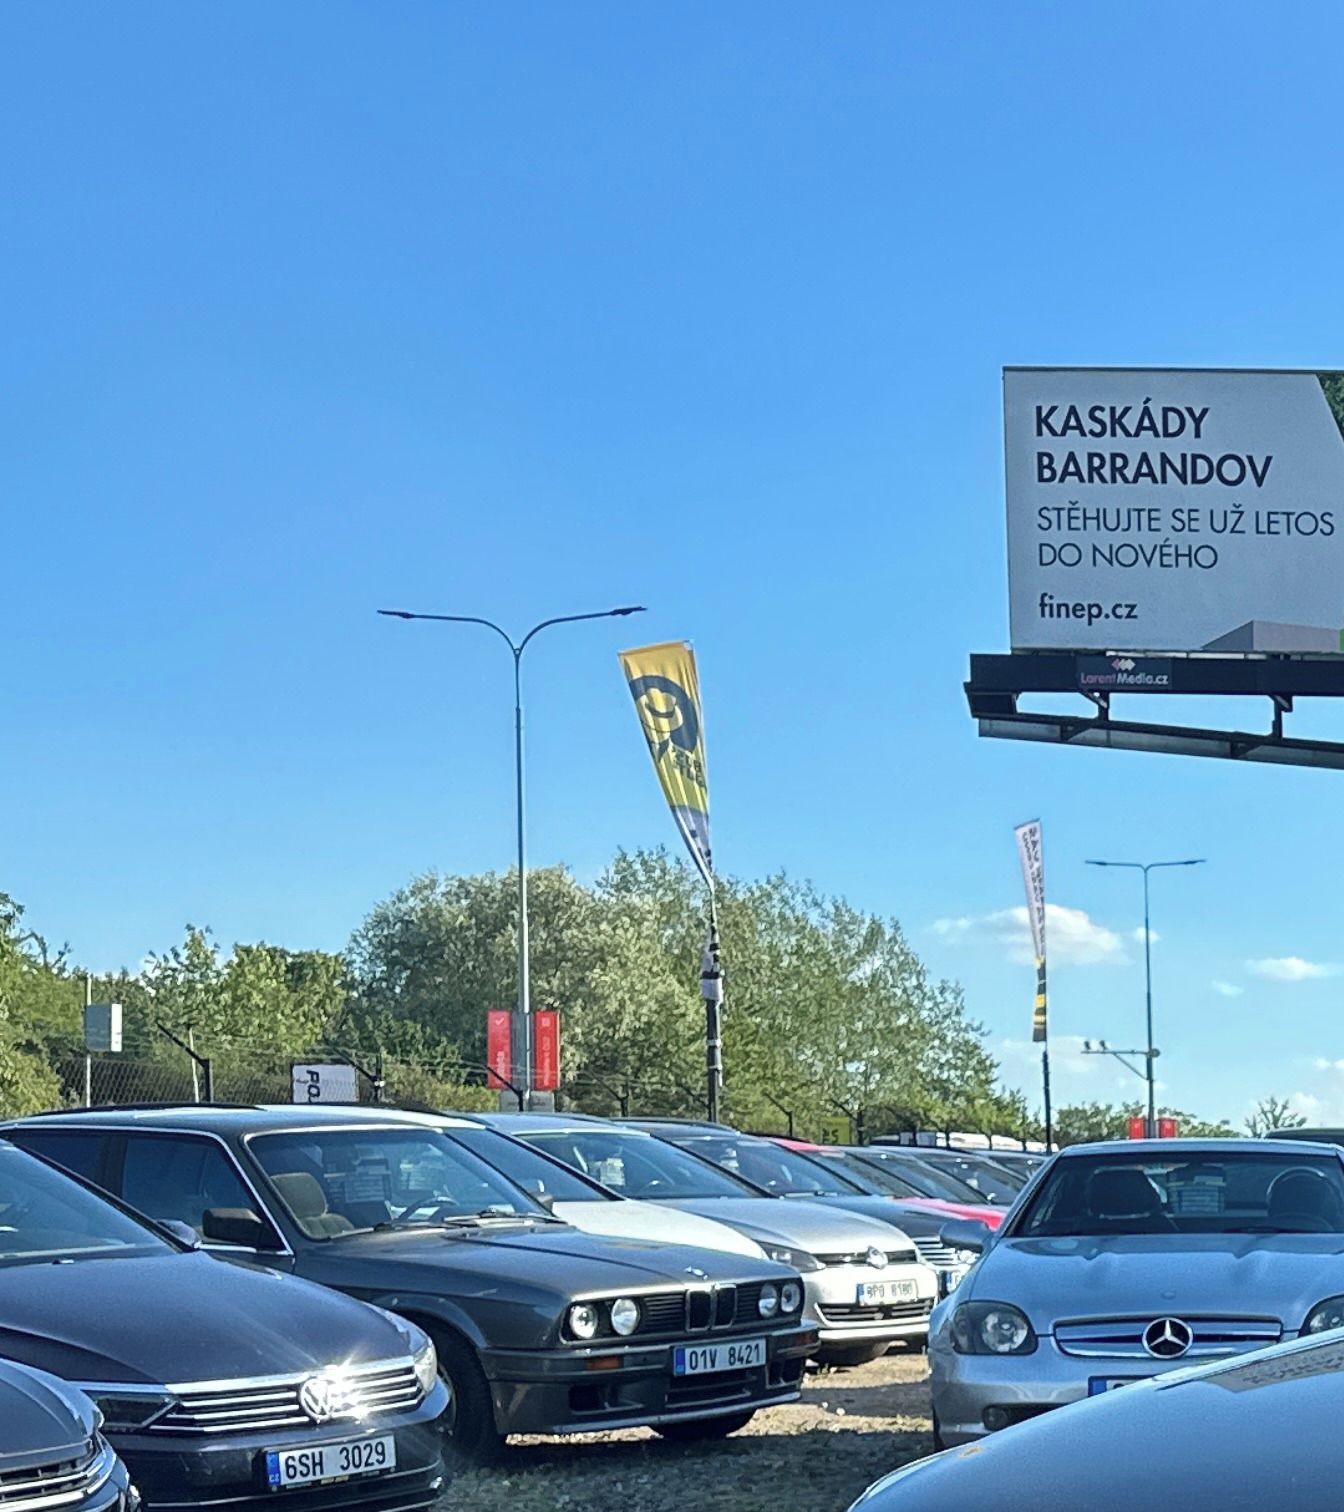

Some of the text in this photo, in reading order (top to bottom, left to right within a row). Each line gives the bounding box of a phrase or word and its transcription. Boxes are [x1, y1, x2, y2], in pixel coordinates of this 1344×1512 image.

[1035, 397, 1210, 439] KASKÁDY
[1036, 451, 1272, 488] BARRANDOV
[1038, 500, 1334, 538] STĚHUJTE SE UŽ LETOS
[1038, 536, 1219, 569] DO NOVÉHO
[1039, 592, 1138, 626] finep.cz
[728, 1344, 760, 1366] 8421
[285, 1441, 386, 1479] 6SH 3029
